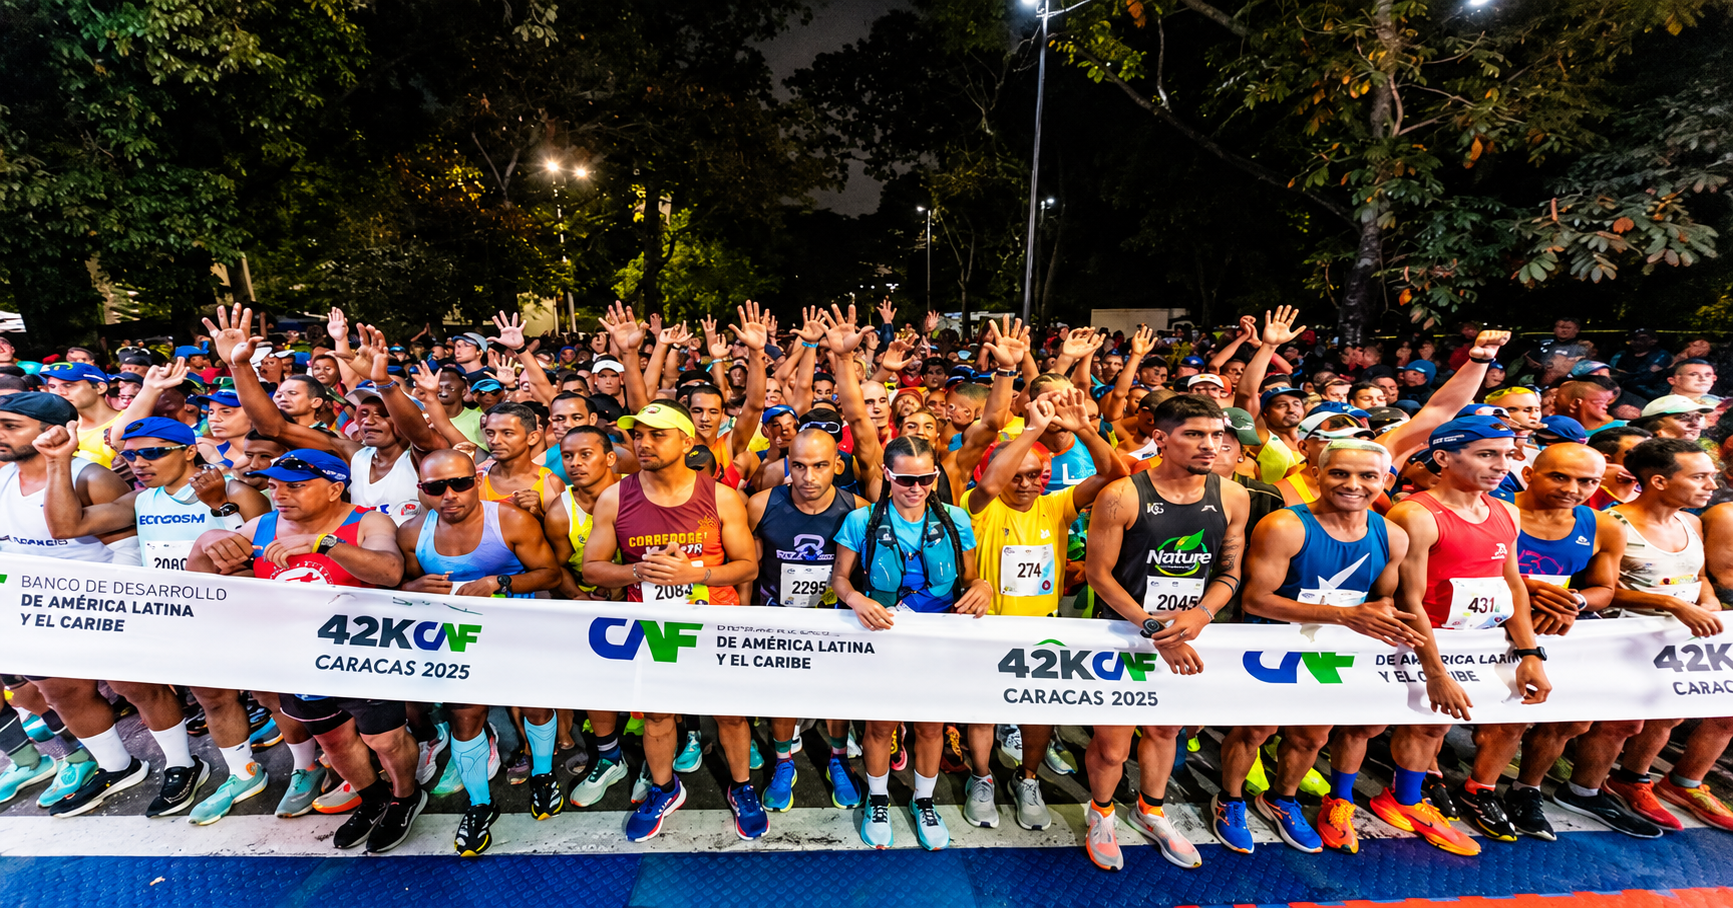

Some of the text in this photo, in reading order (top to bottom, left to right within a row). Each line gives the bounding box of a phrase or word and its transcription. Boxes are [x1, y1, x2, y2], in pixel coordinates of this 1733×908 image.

[1146, 549, 1212, 564] Nature
[1017, 562, 1042, 578] 274
[21, 575, 80, 592] BANCO
[85, 579, 107, 594] DE
[791, 580, 828, 595] 2295
[21, 593, 194, 617] DE AMÉRICA LATINA
[1156, 594, 1199, 612] 2045
[1468, 597, 1495, 614] 431
[20, 612, 126, 632] Y EL CARIBE
[588, 616, 704, 663] CAF
[716, 635, 875, 654] DE AMÉRICA LATINA
[716, 653, 812, 670] Y EL CARIBE
[1375, 654, 1396, 666] DE
[1653, 642, 1733, 673] 42K
[315, 654, 471, 680] CARACAS 2025
[1378, 670, 1390, 683] Y
[1393, 670, 1417, 683] EL
[1003, 688, 1159, 707] CARACAS 2025
